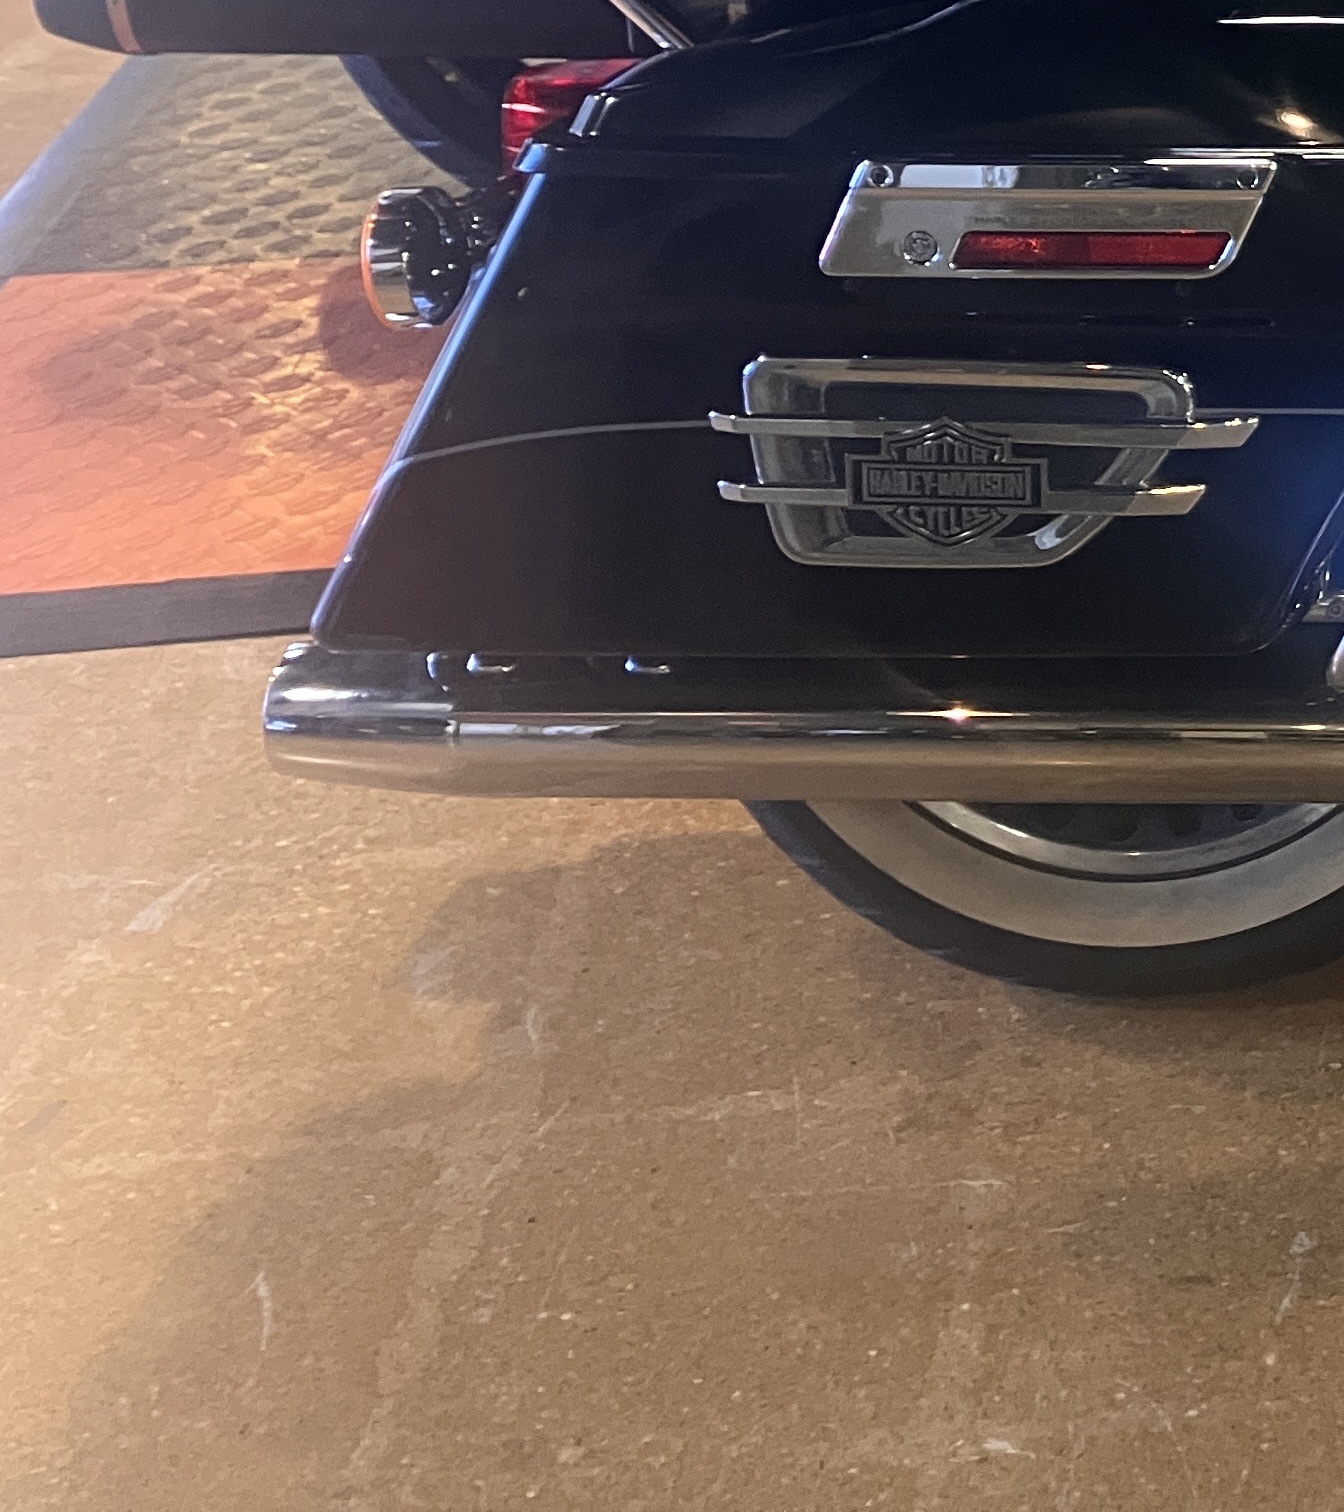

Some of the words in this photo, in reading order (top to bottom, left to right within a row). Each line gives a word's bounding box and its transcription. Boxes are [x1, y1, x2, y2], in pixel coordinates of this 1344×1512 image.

[906, 439, 989, 464] MOTOR
[868, 469, 1025, 499] HARLEY-DAVIDSON
[908, 505, 991, 537] CYCLES
